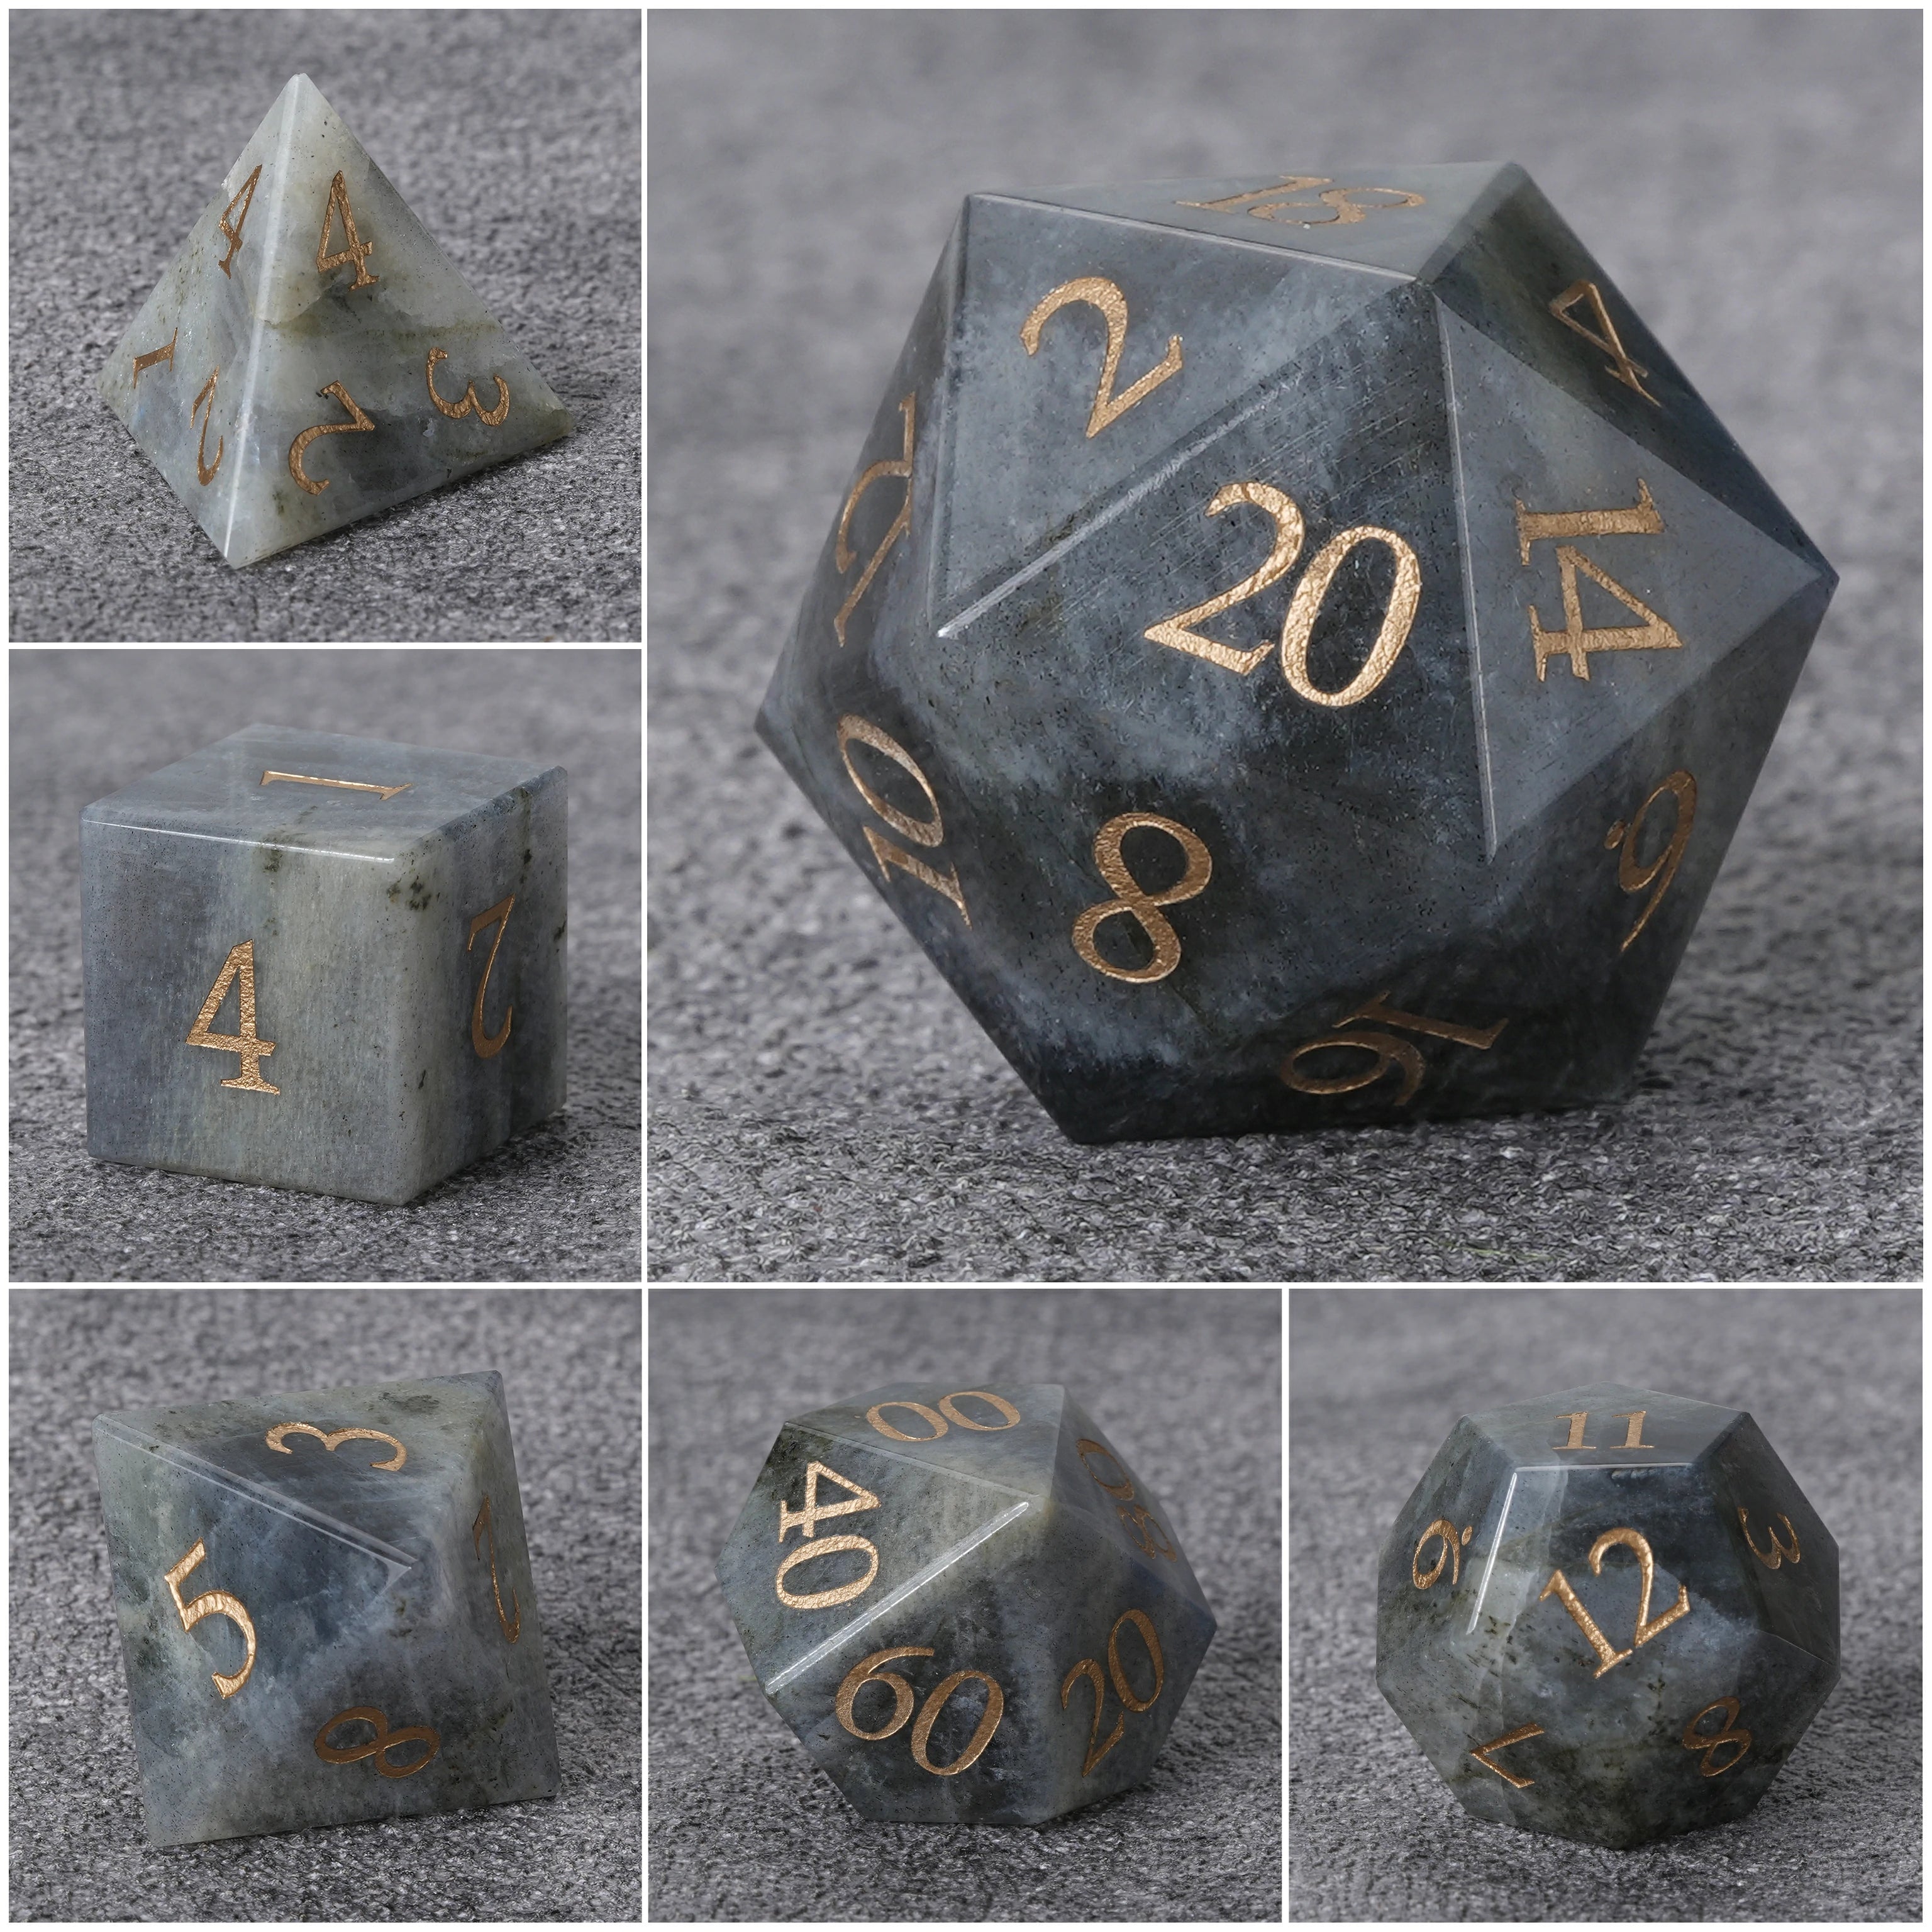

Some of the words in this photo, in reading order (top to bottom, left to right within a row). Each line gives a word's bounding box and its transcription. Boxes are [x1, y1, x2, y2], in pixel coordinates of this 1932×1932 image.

[218, 164, 262, 279] 4
[314, 170, 380, 292] 4
[1173, 174, 1427, 225] 18
[132, 328, 179, 389] 1
[425, 347, 510, 427] 3
[1019, 275, 1184, 438] 2
[1550, 279, 1662, 408] 4
[189, 364, 223, 486] 2
[287, 380, 375, 496] 2
[1143, 480, 1421, 708] 20
[1511, 478, 1684, 682] 14
[259, 770, 413, 801] 1
[837, 713, 973, 931] 10
[1072, 811, 1213, 984] 8
[184, 939, 281, 1096] 4
[467, 894, 516, 1059] 2
[1279, 990, 1508, 1106] 16
[265, 1421, 408, 1472] 3
[865, 1391, 1021, 1443] 00
[1552, 1410, 1655, 1450] 11
[775, 1460, 881, 1609] 40
[1075, 1438, 1178, 1563] 80
[1737, 1507, 1802, 1570] 3
[164, 1536, 257, 1699] 5
[1538, 1526, 1690, 1679] 12
[314, 1706, 441, 1779] 8
[835, 1645, 1005, 1776] 60
[1060, 1608, 1164, 1778] 20
[1683, 1696, 1752, 1778] 8
[1470, 1722, 1545, 1789] 7
